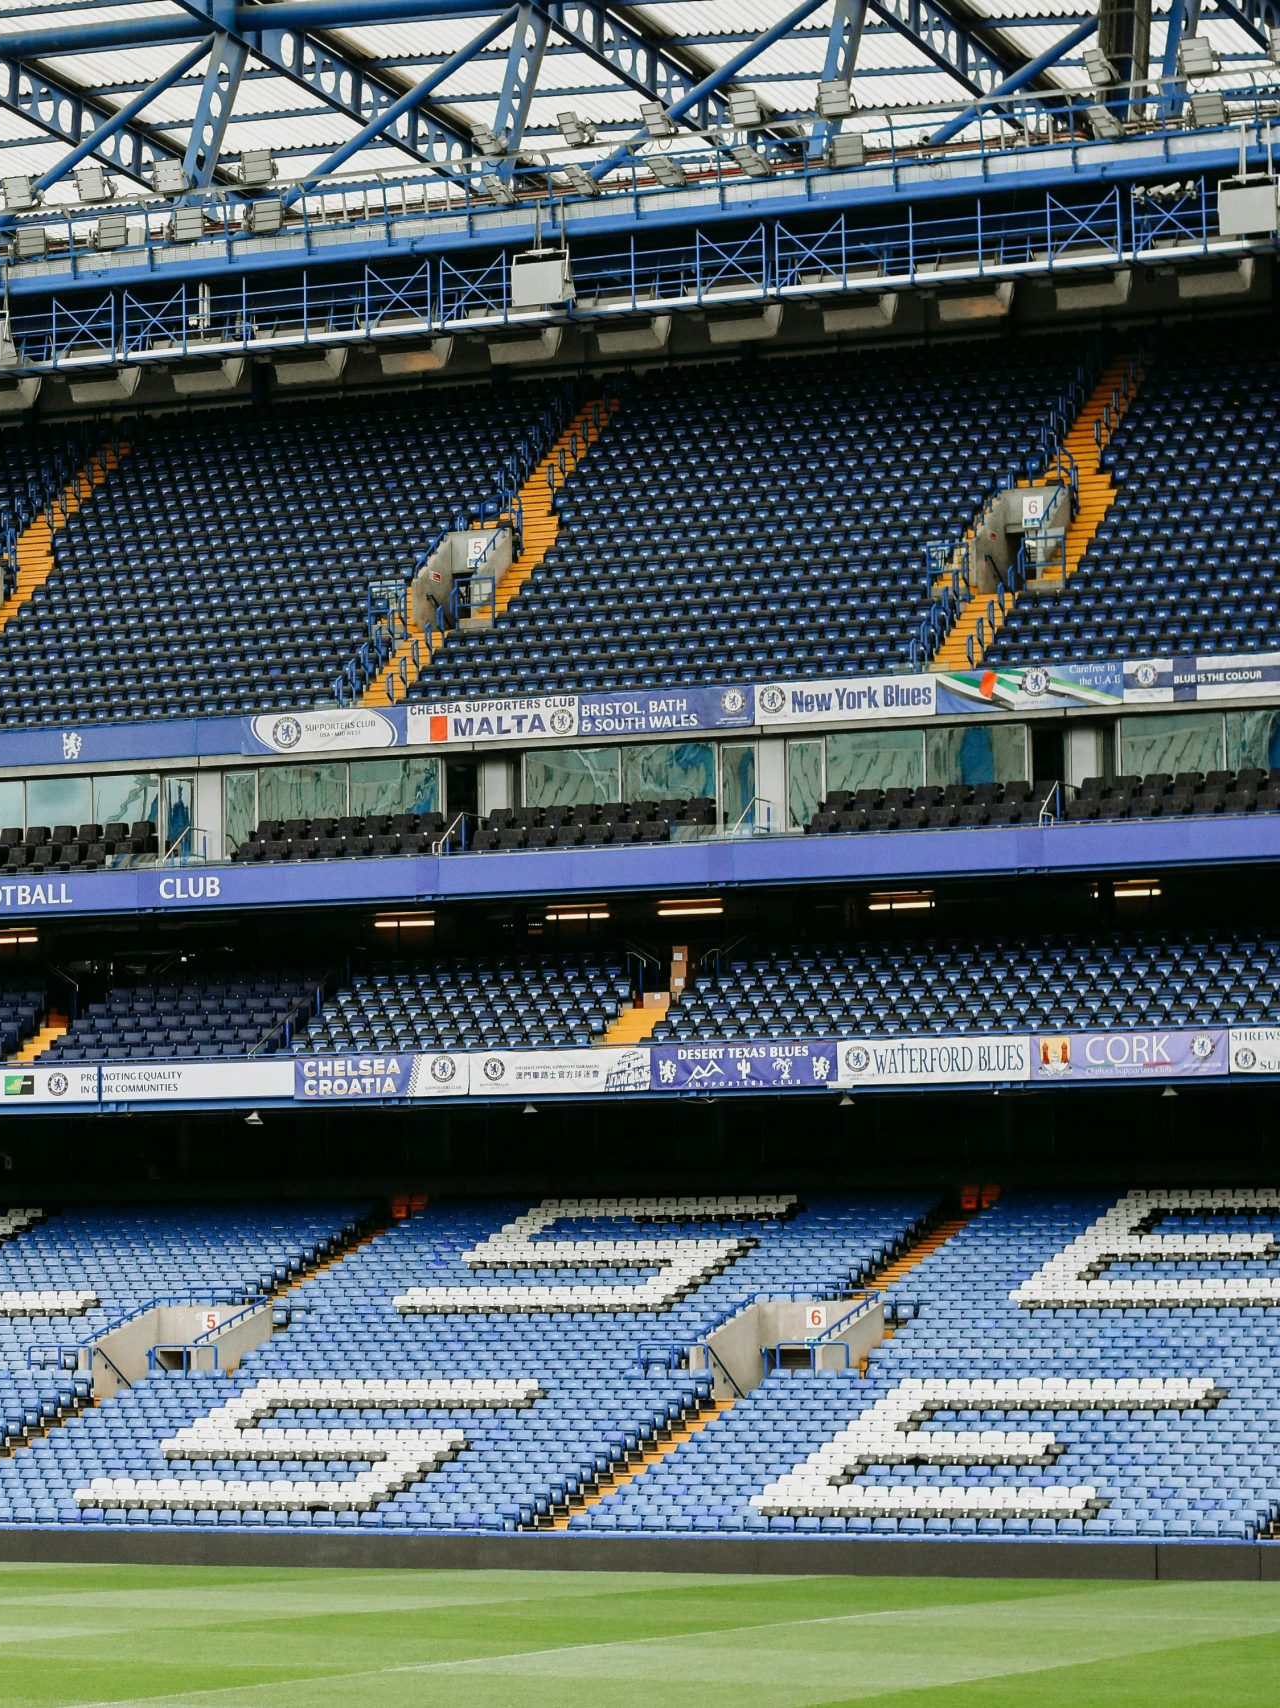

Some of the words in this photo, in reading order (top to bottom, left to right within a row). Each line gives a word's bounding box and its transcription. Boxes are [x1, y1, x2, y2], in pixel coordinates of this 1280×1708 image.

[1028, 500, 1038, 514] 6
[473, 541, 482, 555] 5
[1069, 664, 1105, 674] Carefree
[1107, 663, 1116, 672] in
[1079, 676, 1093, 686] the
[1173, 674, 1196, 684] BLUE
[1197, 674, 1206, 683] IS
[1206, 673, 1225, 682] THE
[1225, 671, 1263, 681] COLOUR
[791, 690, 832, 713] New
[834, 686, 880, 711] York
[883, 684, 932, 707] Blues
[410, 704, 462, 716] CHELSEA
[465, 699, 541, 713] SUPPORTERS
[544, 697, 576, 708] CLUB
[581, 702, 646, 717] BRISTOL,
[648, 699, 687, 713] BATH
[304, 721, 355, 732] SUPPORTERS
[356, 720, 376, 728] CLUB
[453, 713, 546, 737] MALTA
[581, 720, 593, 732] &
[594, 717, 646, 732] SOUTH
[648, 714, 698, 729] WALES
[159, 876, 221, 900] CLUB
[677, 1048, 725, 1060] DESERT
[728, 1047, 767, 1059] TEXAS
[769, 1046, 809, 1058] BLUES
[1085, 1034, 1172, 1066] CORK
[872, 1043, 974, 1075] WATERFORD
[978, 1044, 1025, 1072] BLUES
[303, 1058, 401, 1078] CHELSEA
[80, 1072, 136, 1082] PROMOTING
[138, 1070, 183, 1082] EQUALITY
[687, 1080, 764, 1088] SUPPORTERS
[772, 1079, 802, 1087] CLUB
[80, 1085, 90, 1094] IN
[91, 1084, 113, 1094] OUR
[114, 1083, 179, 1093] COMMUNITIES
[303, 1077, 397, 1097] CROATIA
[206, 1314, 216, 1330] 5
[811, 1310, 822, 1325] 6
